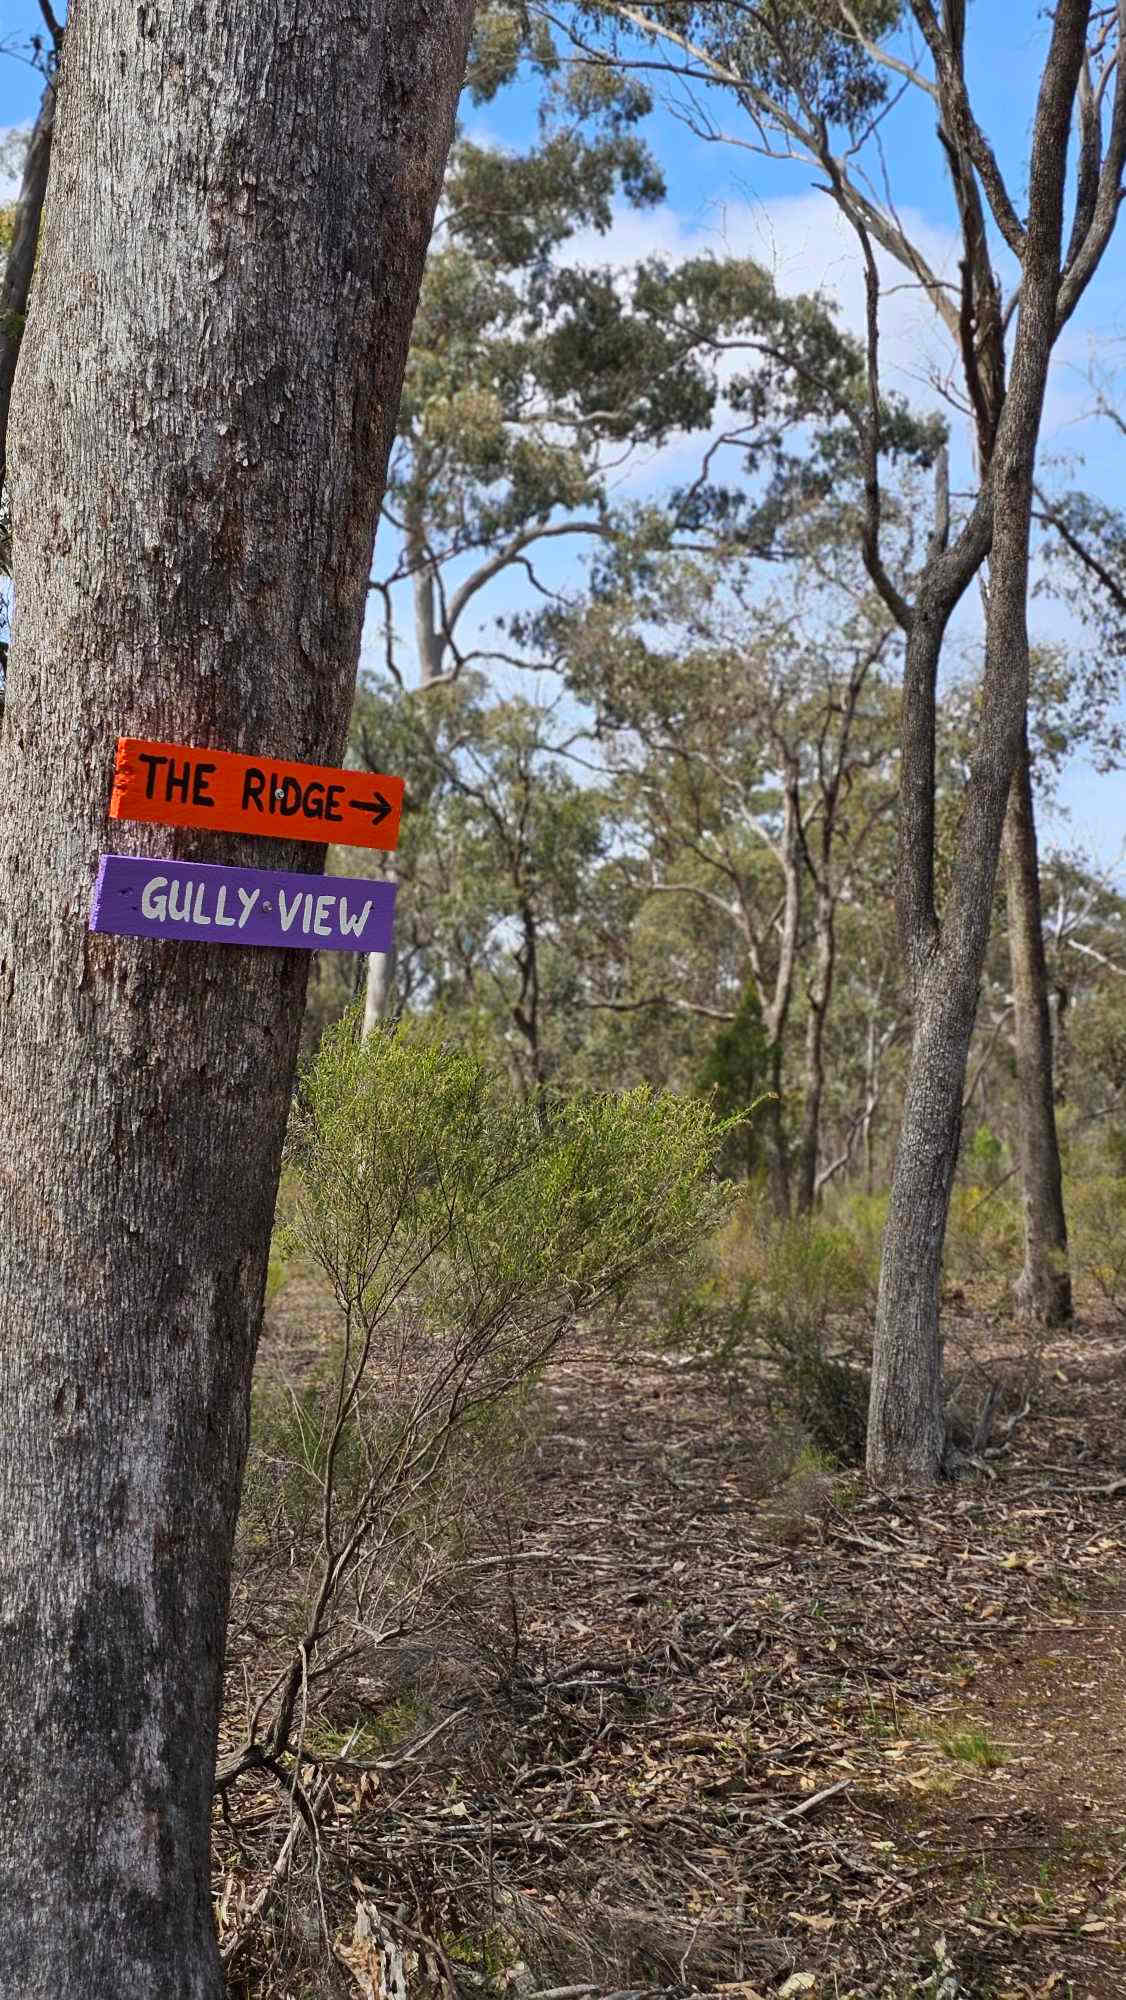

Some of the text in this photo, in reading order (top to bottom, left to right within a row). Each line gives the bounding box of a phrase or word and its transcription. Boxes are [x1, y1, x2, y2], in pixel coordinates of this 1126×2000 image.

[139, 753, 346, 822] THE RIDGE
[141, 876, 373, 938] GULLY VIEW
